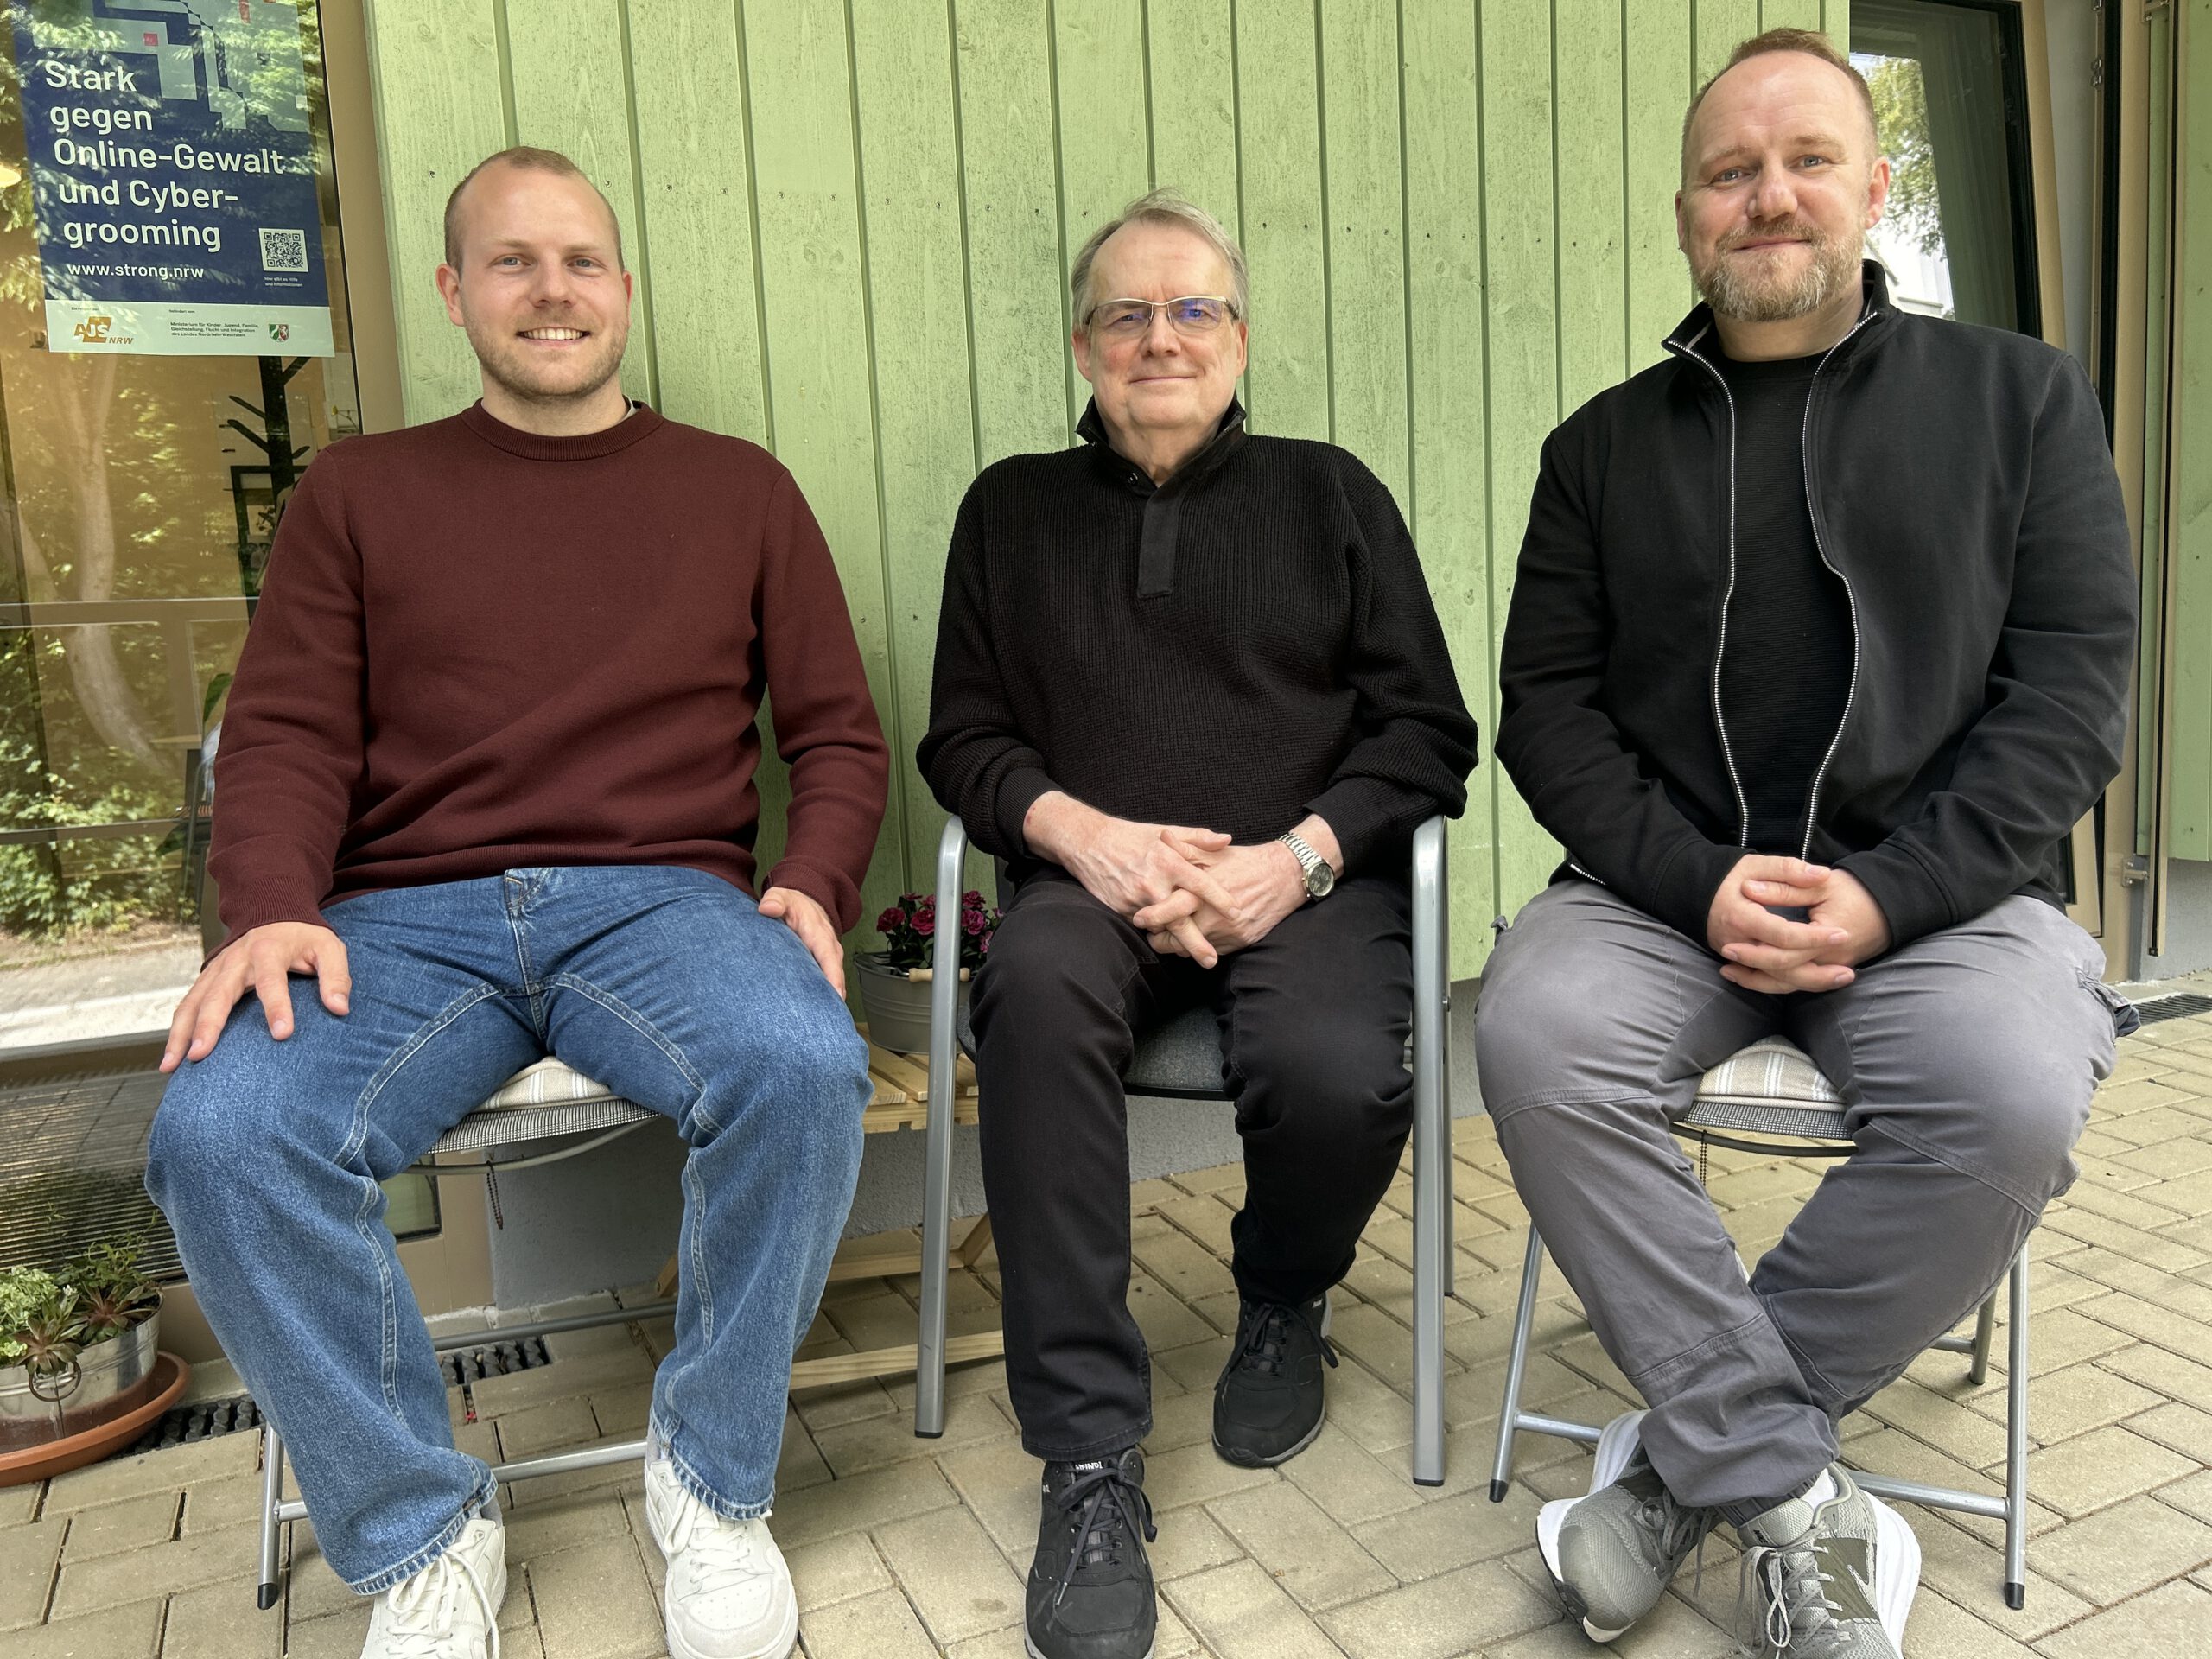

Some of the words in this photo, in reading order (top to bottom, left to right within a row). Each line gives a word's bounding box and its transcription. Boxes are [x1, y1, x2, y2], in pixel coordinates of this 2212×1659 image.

[44, 60, 137, 92] Stark
[50, 105, 153, 135] gegen
[54, 138, 284, 175] Online-Gewalt
[59, 179, 120, 205] und
[129, 179, 238, 213] Cyber-
[63, 218, 222, 252] grooming
[67, 263, 205, 281] www.strong.nrw
[109, 336, 135, 345] NRW
